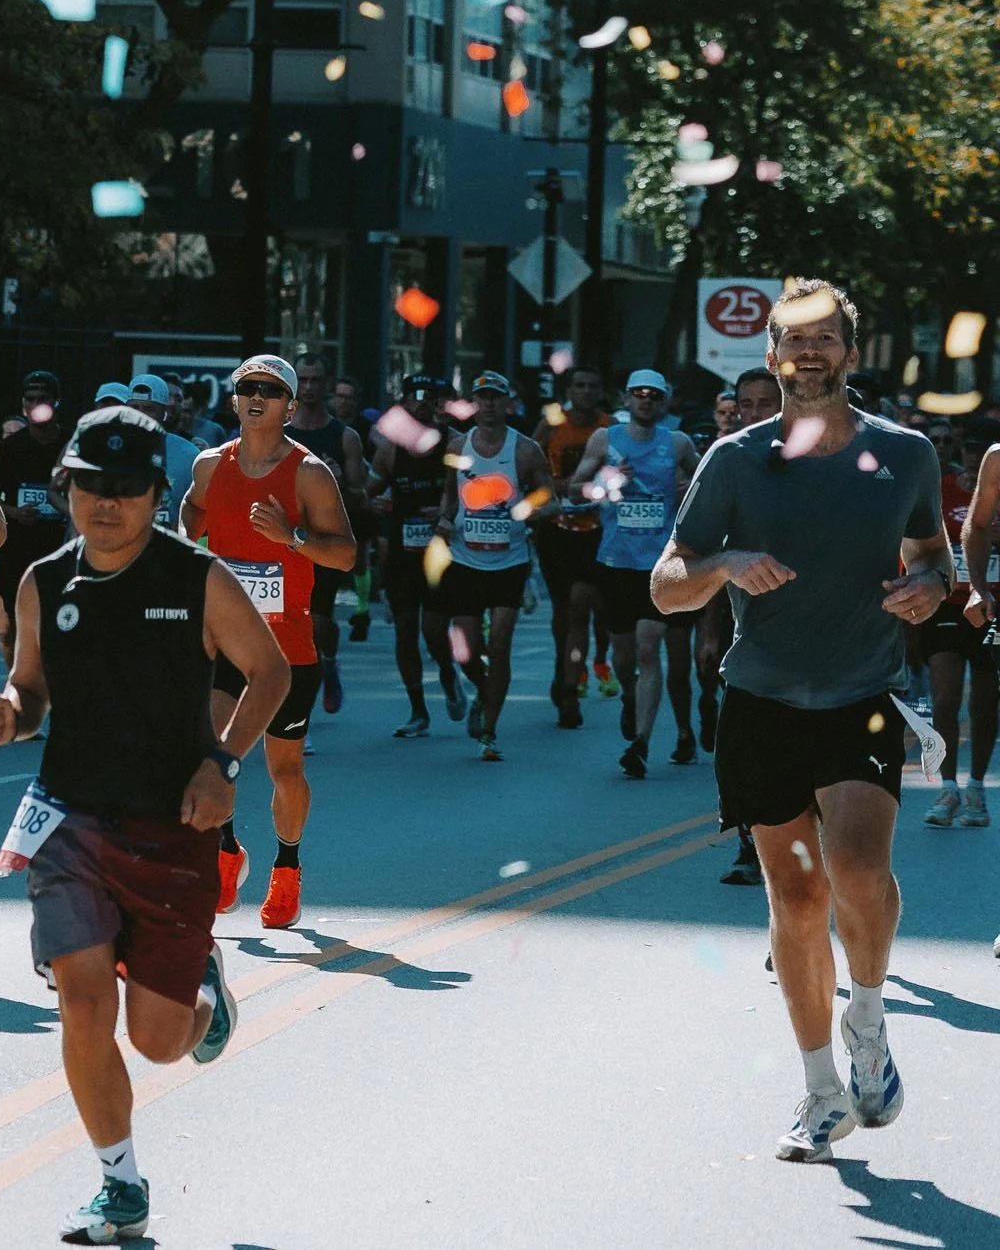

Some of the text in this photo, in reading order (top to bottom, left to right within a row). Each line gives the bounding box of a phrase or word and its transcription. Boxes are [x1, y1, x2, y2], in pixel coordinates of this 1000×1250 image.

[718, 290, 761, 322] 25
[726, 325, 752, 334] MILE
[620, 505, 663, 518] G24586
[465, 520, 510, 534] D10589
[241, 579, 281, 599] 738
